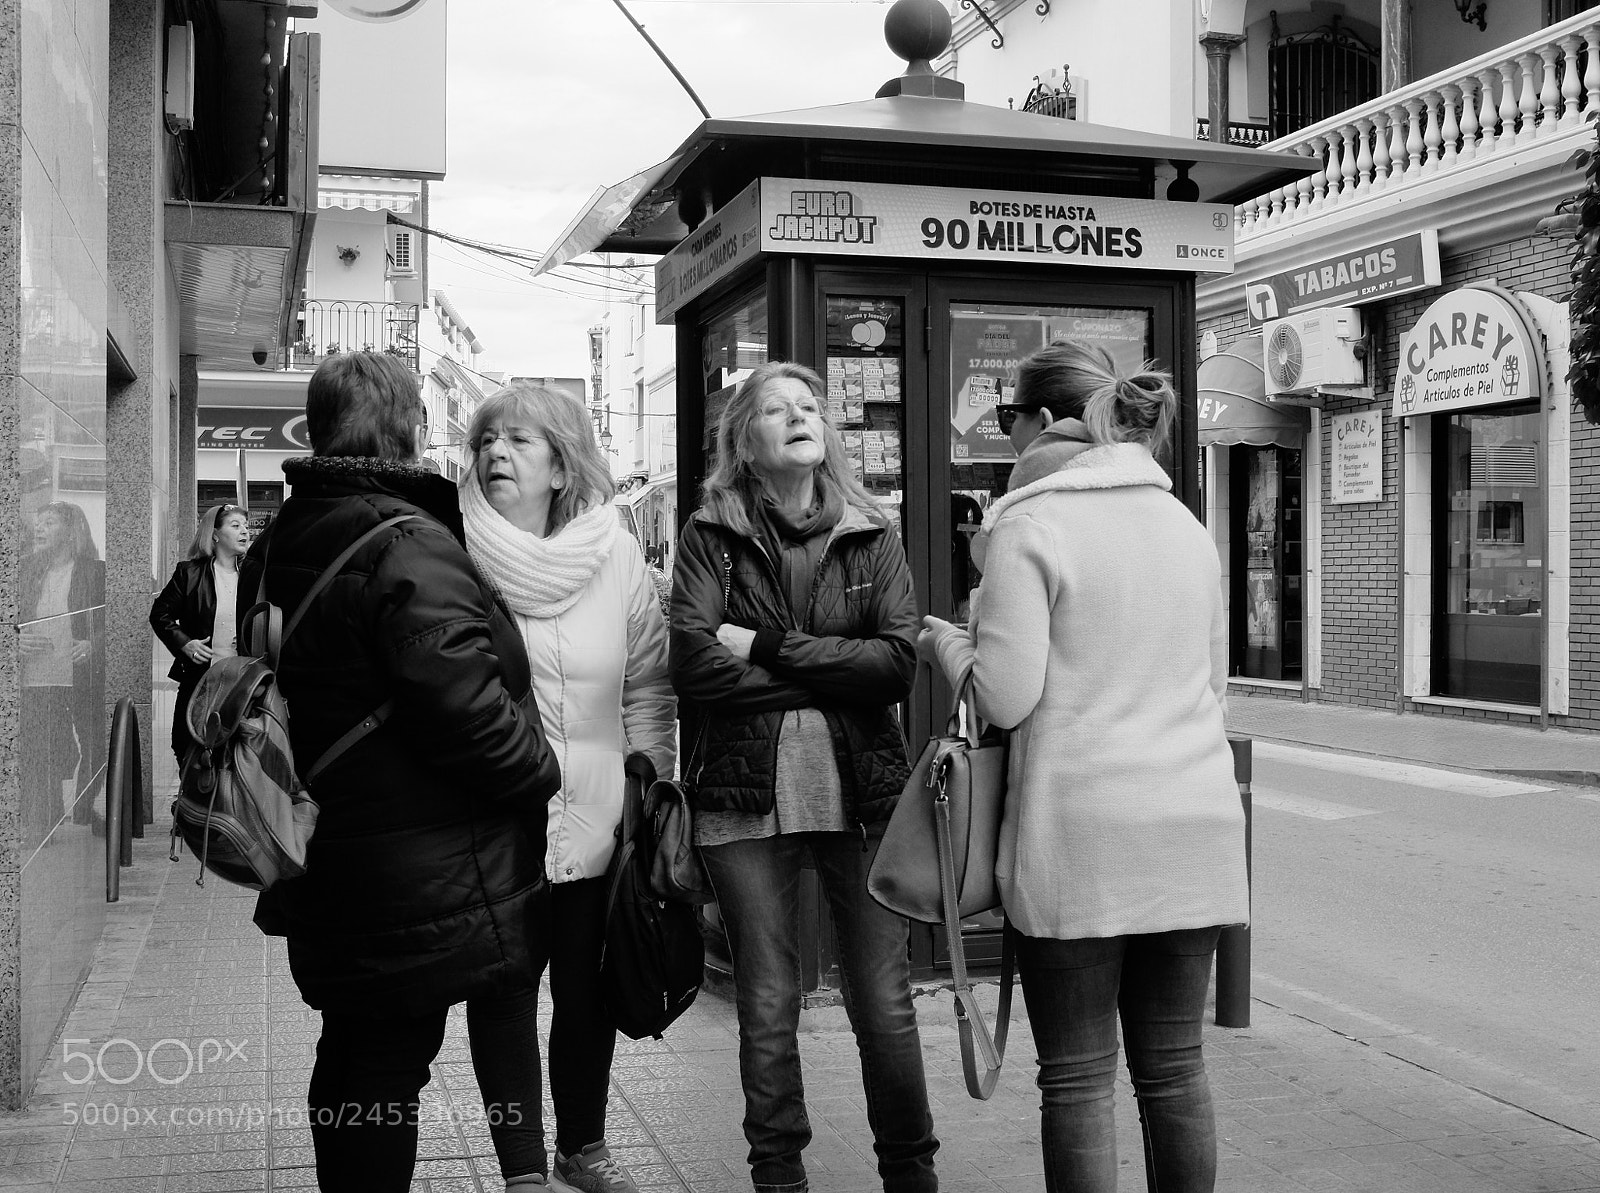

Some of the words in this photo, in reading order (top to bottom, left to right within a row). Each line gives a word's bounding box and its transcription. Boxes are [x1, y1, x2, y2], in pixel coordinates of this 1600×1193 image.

[790, 190, 854, 216] EURO
[969, 200, 1021, 218] BOTES
[1023, 204, 1043, 219] DE
[1045, 205, 1097, 222] HASTA
[769, 213, 877, 244] JACKPOT
[920, 217, 970, 250] 90
[976, 219, 1143, 259] MILLONES
[1190, 247, 1225, 259] ONCE
[1294, 247, 1397, 297] TABACOS
[1361, 286, 1378, 296] EXP.
[1388, 280, 1394, 288] 7
[984, 332, 996, 340] DÍA
[1406, 311, 1514, 375] CAREY
[968, 358, 1020, 369] 17.000.00
[1426, 362, 1490, 384] Complementos
[1422, 386, 1461, 404] Articulos
[1463, 382, 1474, 398] de
[1477, 378, 1494, 396] Piel
[1197, 397, 1229, 423] EY
[1337, 418, 1375, 441] CAREY
[1368, 440, 1377, 448] Piel
